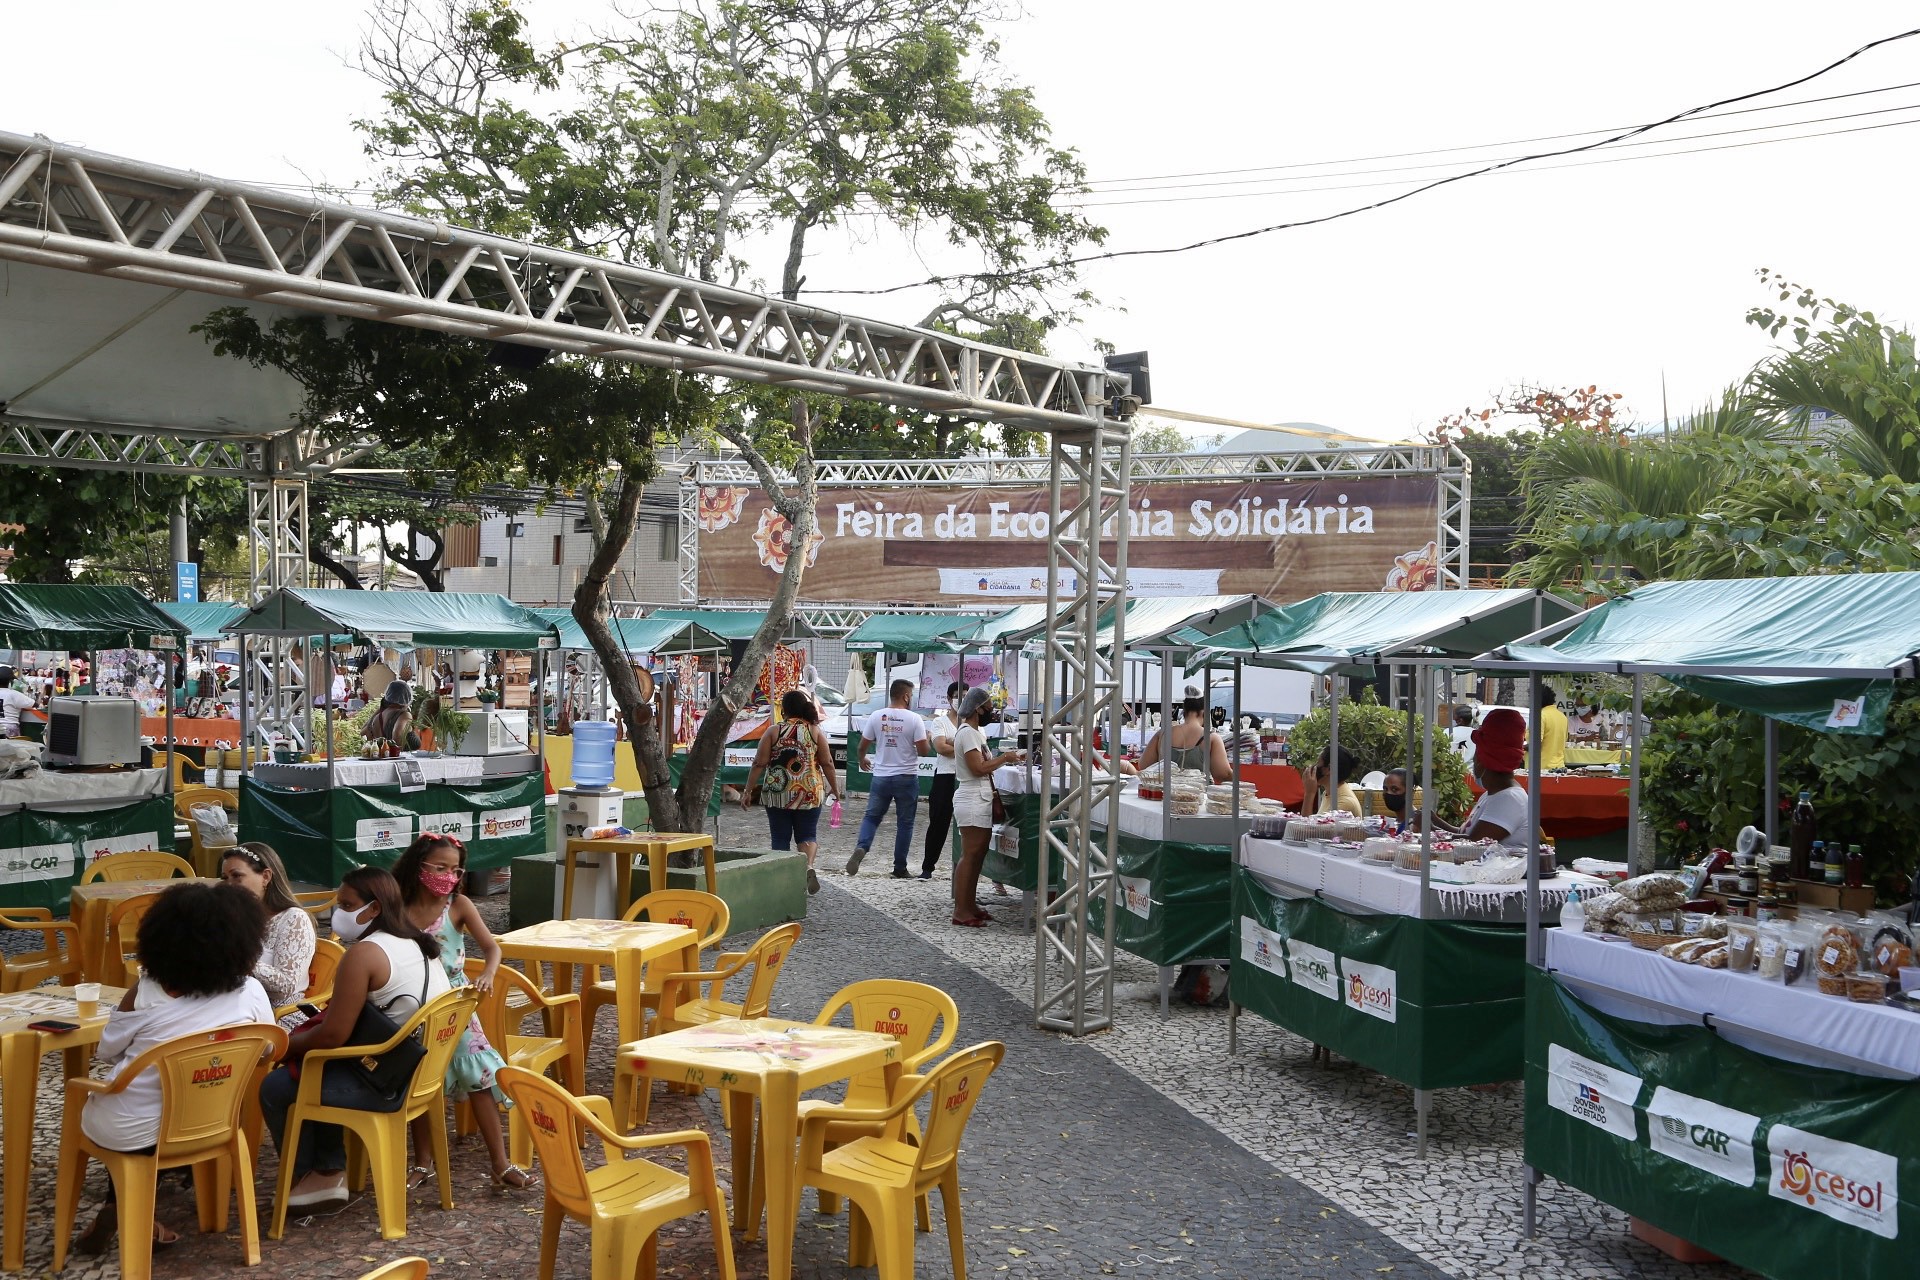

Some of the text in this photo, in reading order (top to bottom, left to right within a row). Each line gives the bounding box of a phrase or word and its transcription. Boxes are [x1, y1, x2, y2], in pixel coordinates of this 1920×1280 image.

[836, 501, 923, 538] Feira
[935, 504, 977, 538] da
[1188, 494, 1375, 537] Solidária
[918, 763, 933, 771] CAR
[441, 822, 462, 834] CAR
[498, 815, 526, 830] cesol
[30, 856, 59, 870] CAR
[1308, 960, 1329, 982] CAR
[1363, 984, 1392, 1009] cesol
[875, 1020, 908, 1036] DEVASSA
[192, 1064, 233, 1085] DEVASSA
[1572, 1104, 1607, 1124] DO ESTADO
[1574, 1096, 1606, 1115] GOVERNO
[1690, 1124, 1731, 1156] CAR
[1815, 1170, 1883, 1212] cesol
